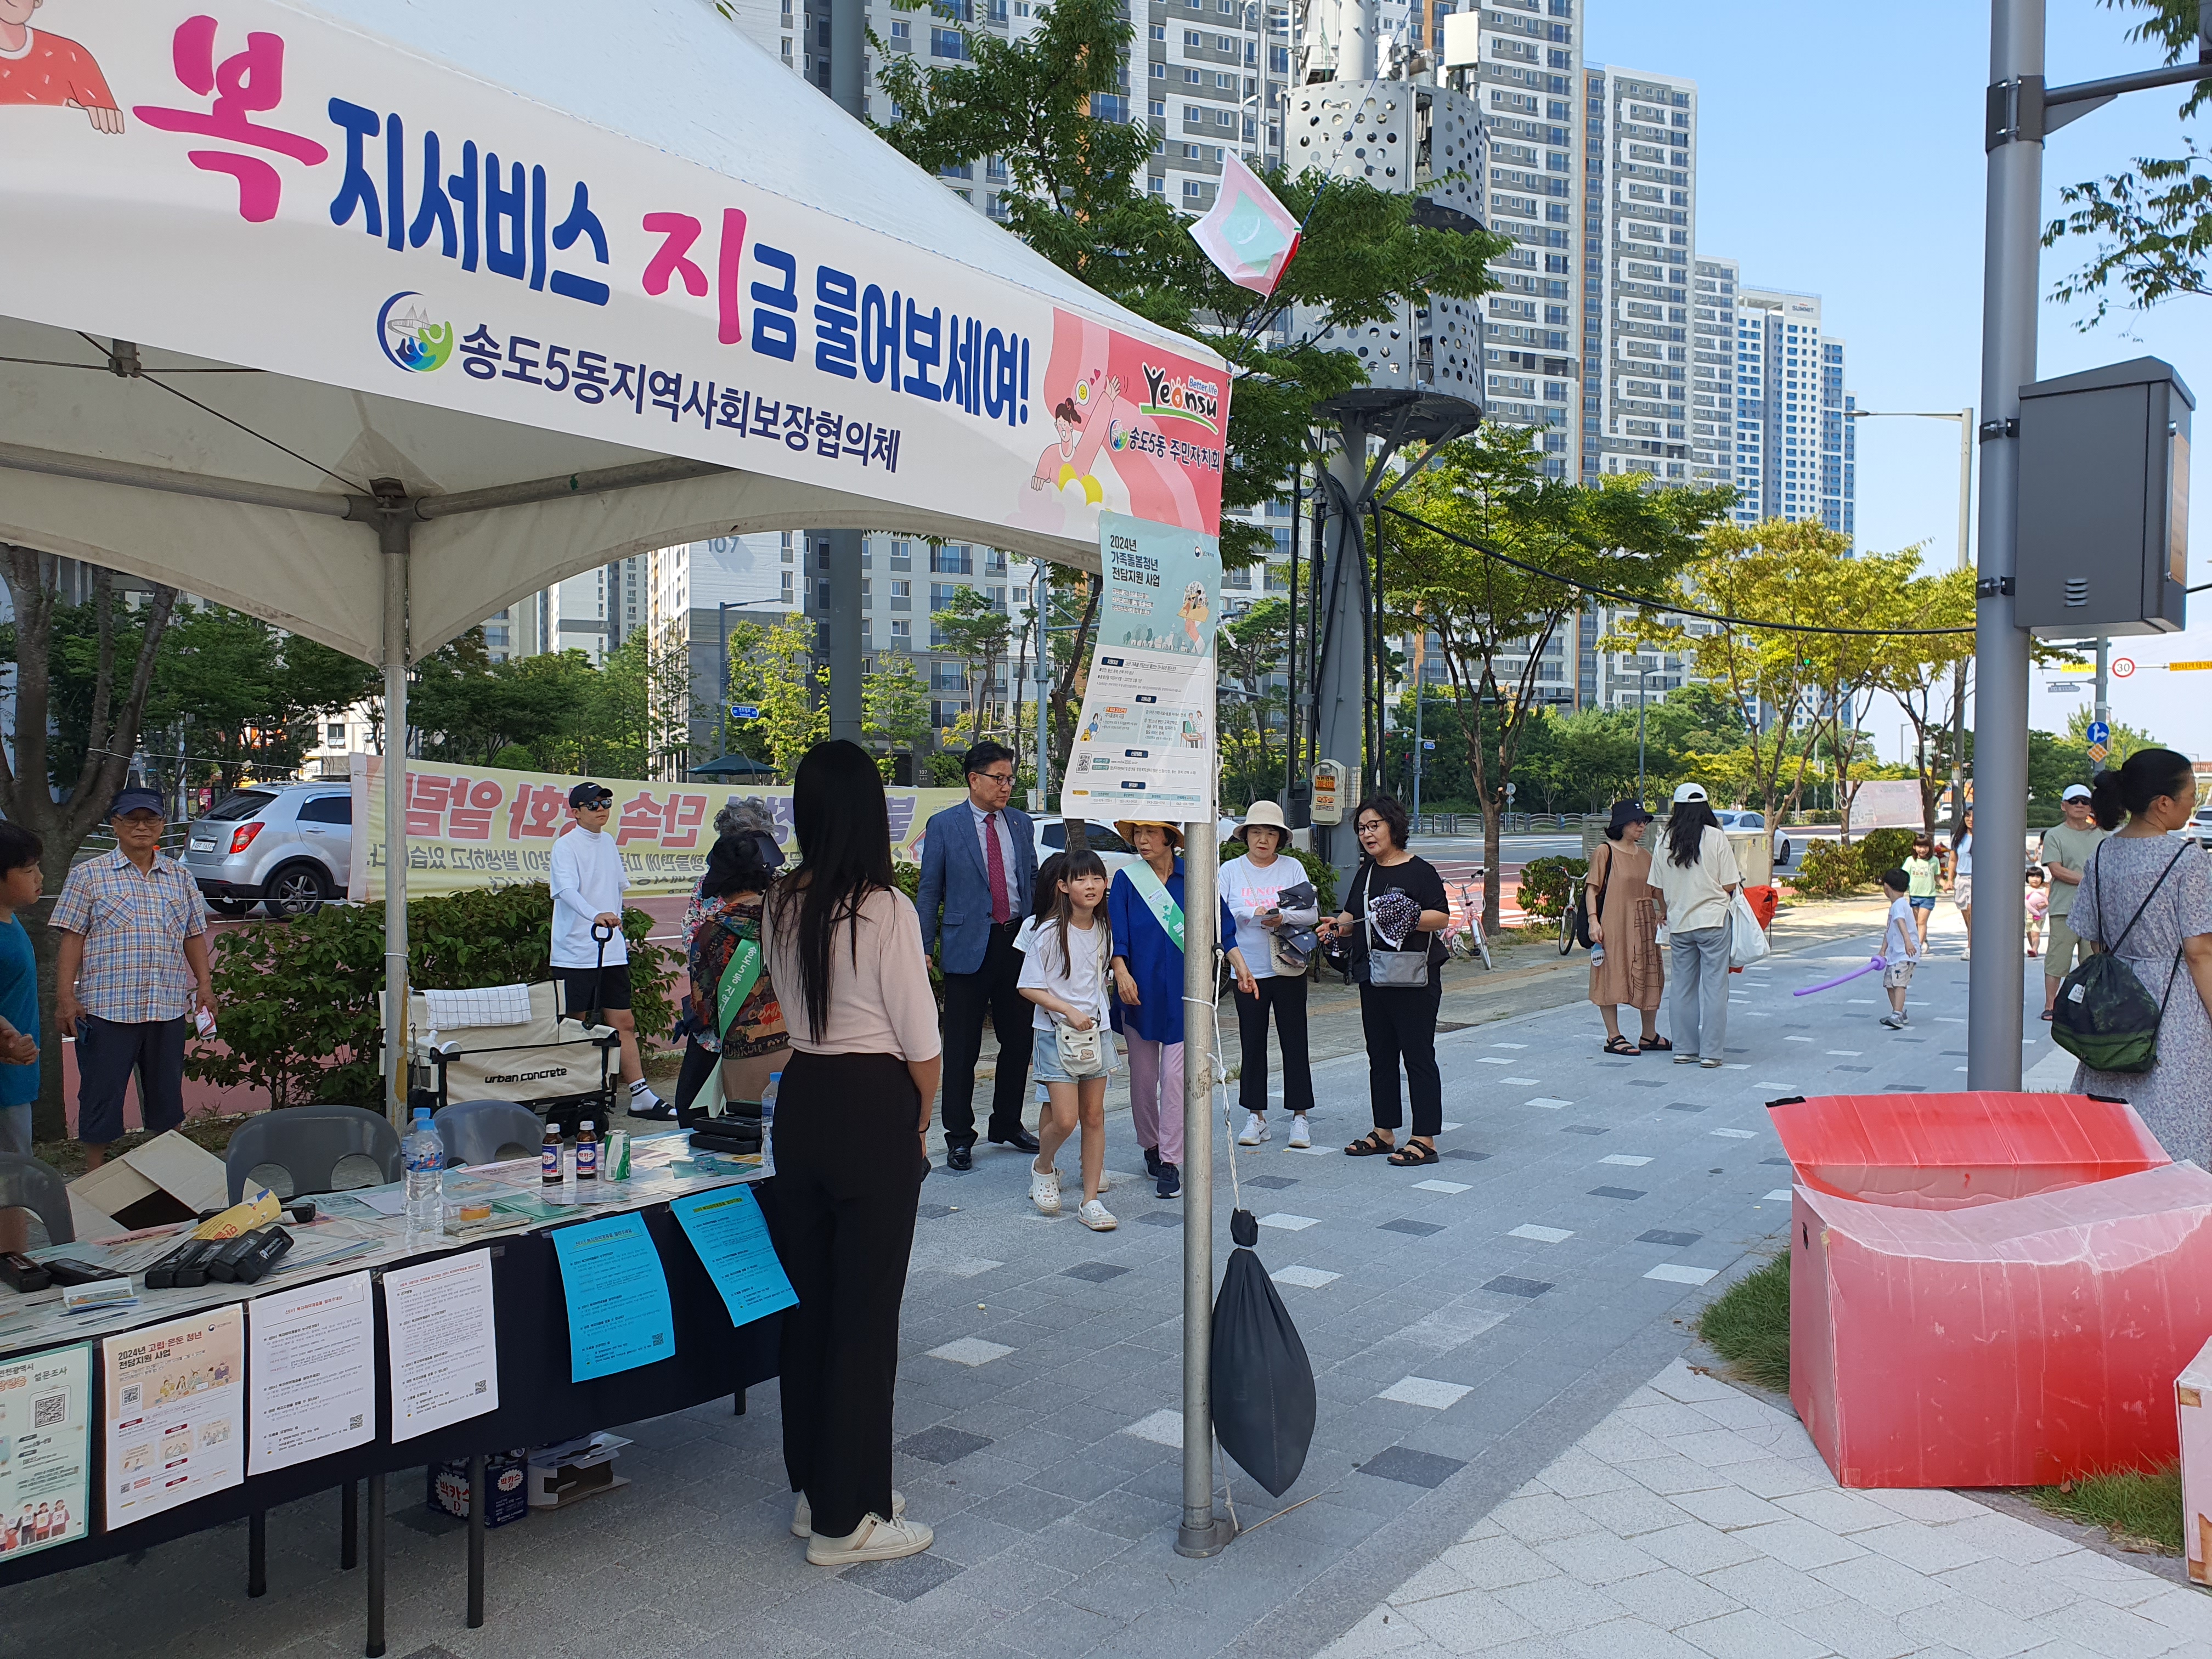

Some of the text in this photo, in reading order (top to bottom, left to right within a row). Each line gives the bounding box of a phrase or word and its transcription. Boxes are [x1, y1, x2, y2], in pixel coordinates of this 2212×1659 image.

[133, 14, 1030, 427] 복지서비스 지금 물어보세여!
[1143, 363, 1217, 419] Yeonsu
[1189, 377, 1218, 395] Better life
[459, 324, 902, 473] 송도5동지역사회보장협의체
[1129, 427, 1220, 473] 송도5동 주민자치회
[707, 535, 739, 554] 107
[1110, 535, 1137, 552] 2024년
[1111, 551, 1158, 572] 가족돌봄청년
[1111, 567, 1160, 587] 전담지원 사업
[2117, 663, 2130, 672] 30
[732, 946, 757, 984] 송도5동
[485, 1067, 567, 1084] urban concrete
[118, 1346, 146, 1361] 2024년
[186, 1331, 202, 1342] 청년
[119, 1348, 171, 1370] 전담지원 사업
[500, 1474, 521, 1485] 박카스
[454, 1501, 461, 1512] D
